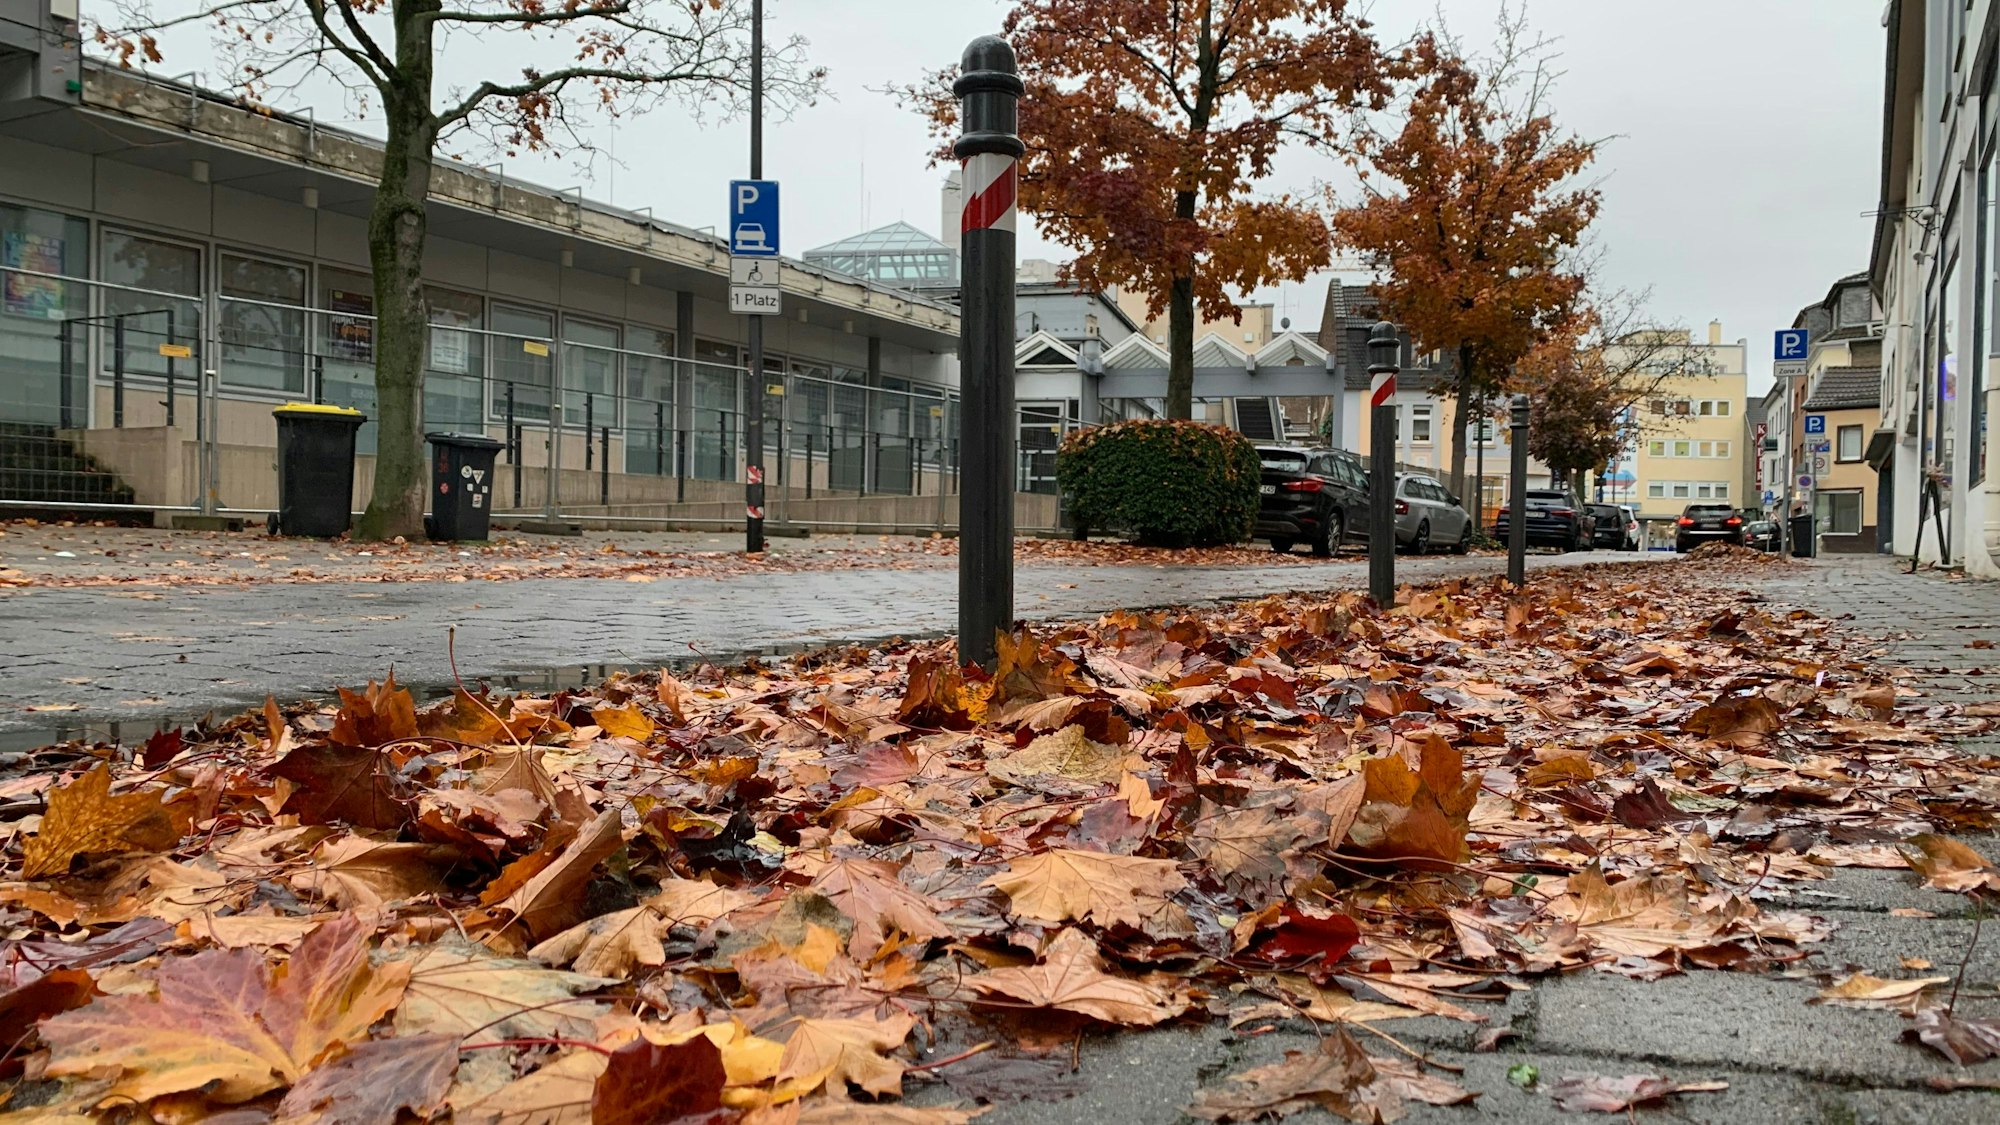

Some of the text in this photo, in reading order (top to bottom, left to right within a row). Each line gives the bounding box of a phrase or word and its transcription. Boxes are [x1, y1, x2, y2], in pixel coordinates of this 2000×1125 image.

[738, 185, 759, 214] P
[734, 293, 776, 307] 1 Platz
[1782, 333, 1800, 356] P
[1808, 417, 1821, 432] P
